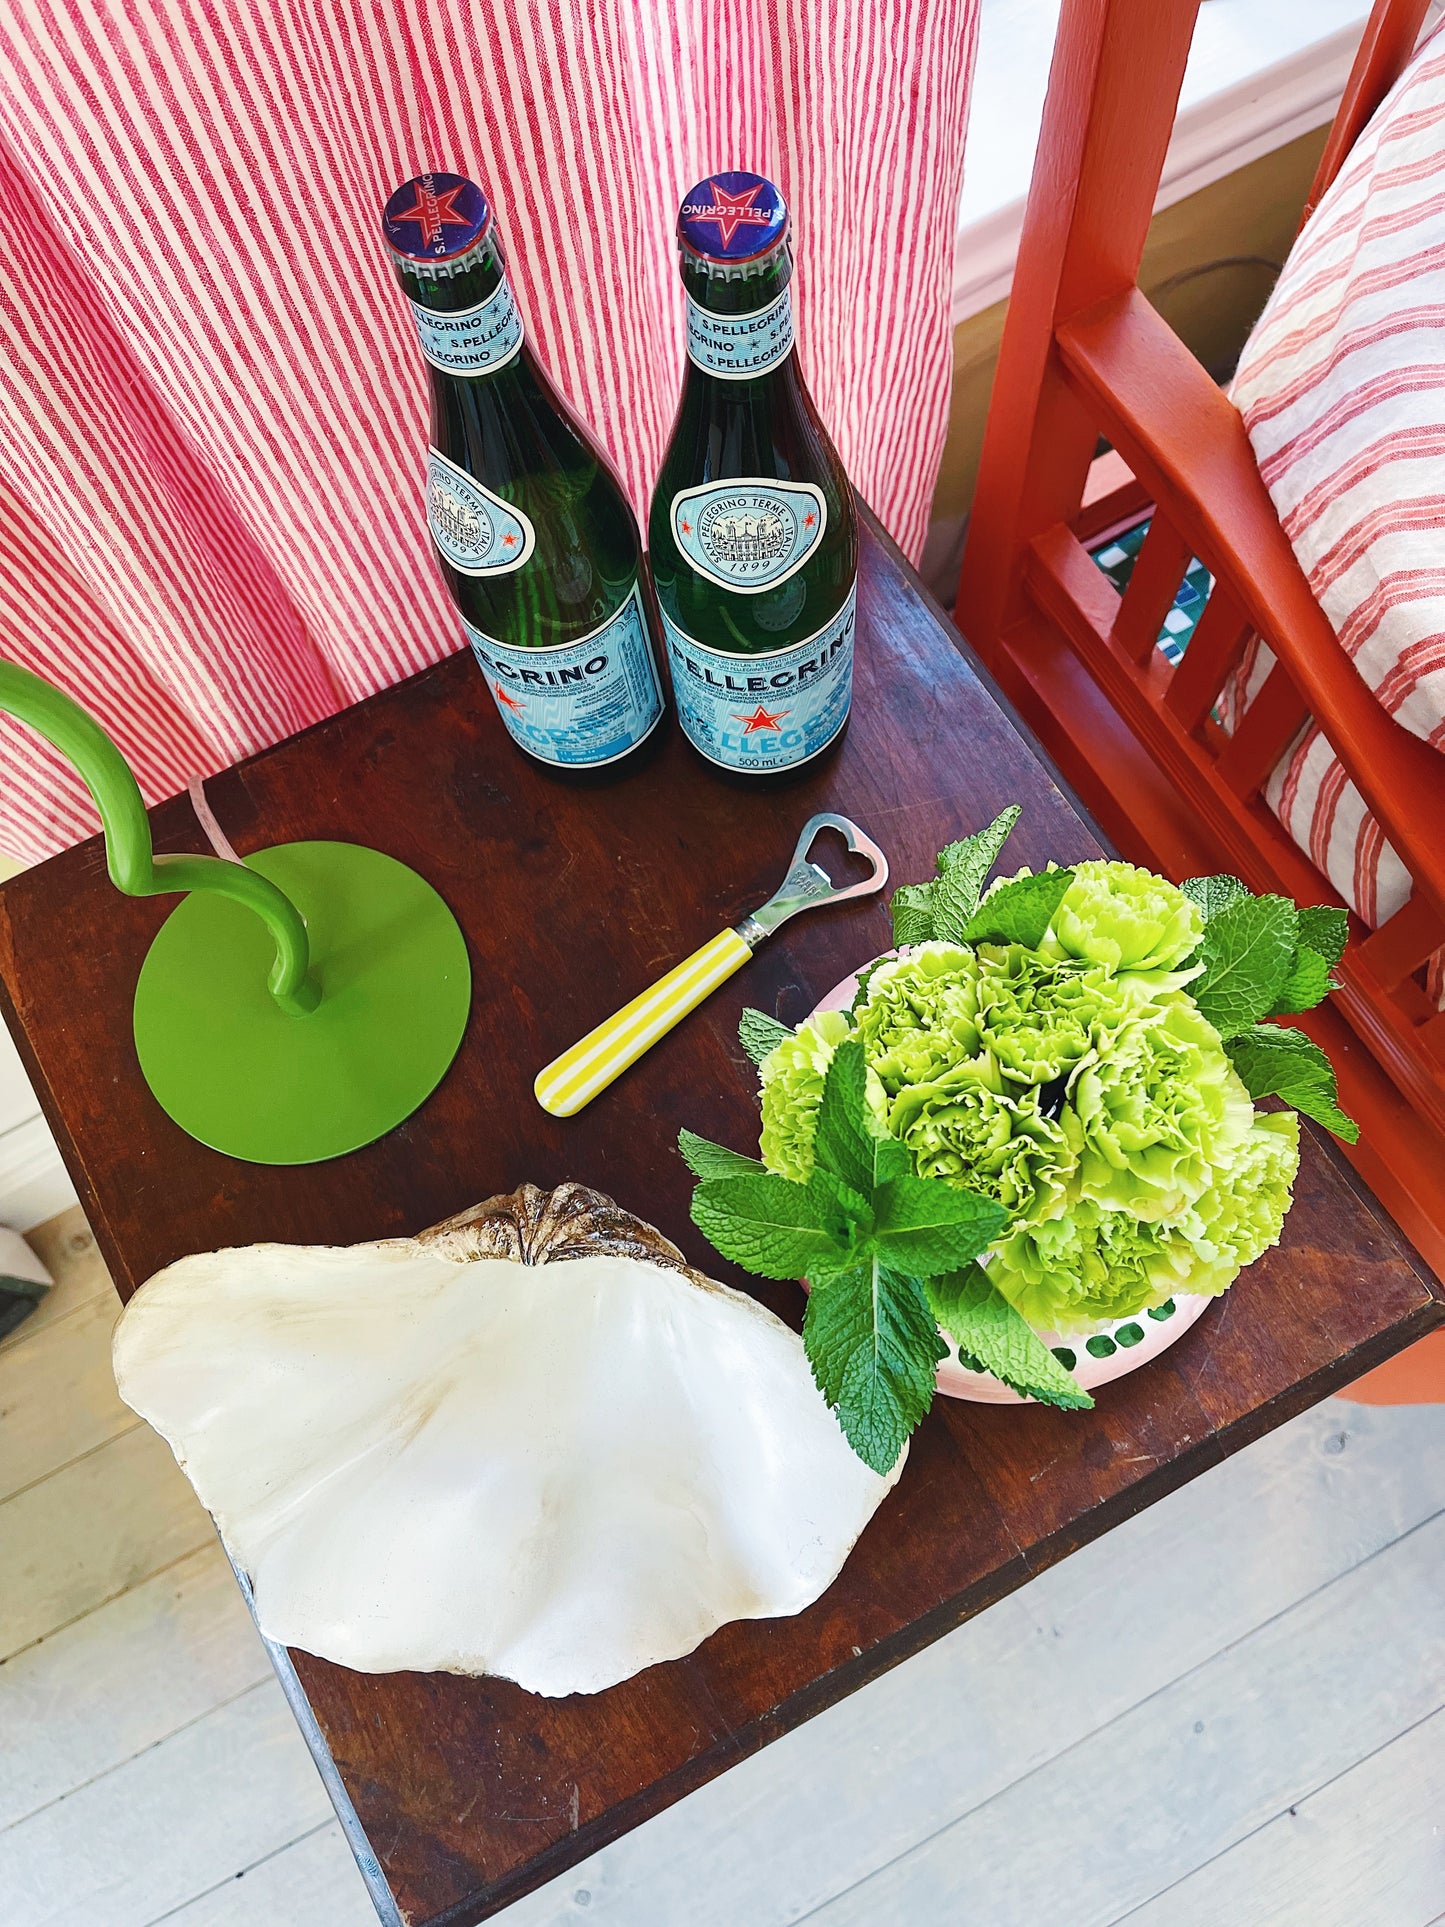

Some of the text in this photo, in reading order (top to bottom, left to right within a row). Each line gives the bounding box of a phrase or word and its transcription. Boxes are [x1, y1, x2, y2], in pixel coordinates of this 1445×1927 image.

[411, 302, 482, 332] LLEGRINO
[702, 293, 788, 335] S.PELLEGRINO
[421, 339, 491, 364] LLEGRINO
[688, 322, 735, 352] EGRINO
[706, 326, 792, 368] S.PELLEGRINO
[454, 483, 484, 517] TERME
[471, 530, 490, 555] ITALIA
[702, 498, 747, 538] PELLEGRINO
[752, 498, 786, 517] TERME
[704, 541, 722, 564] SAN
[776, 526, 794, 559] ITALIA
[729, 560, 771, 573] 1899
[472, 641, 609, 686] EGRINO
[738, 757, 759, 767] 500
